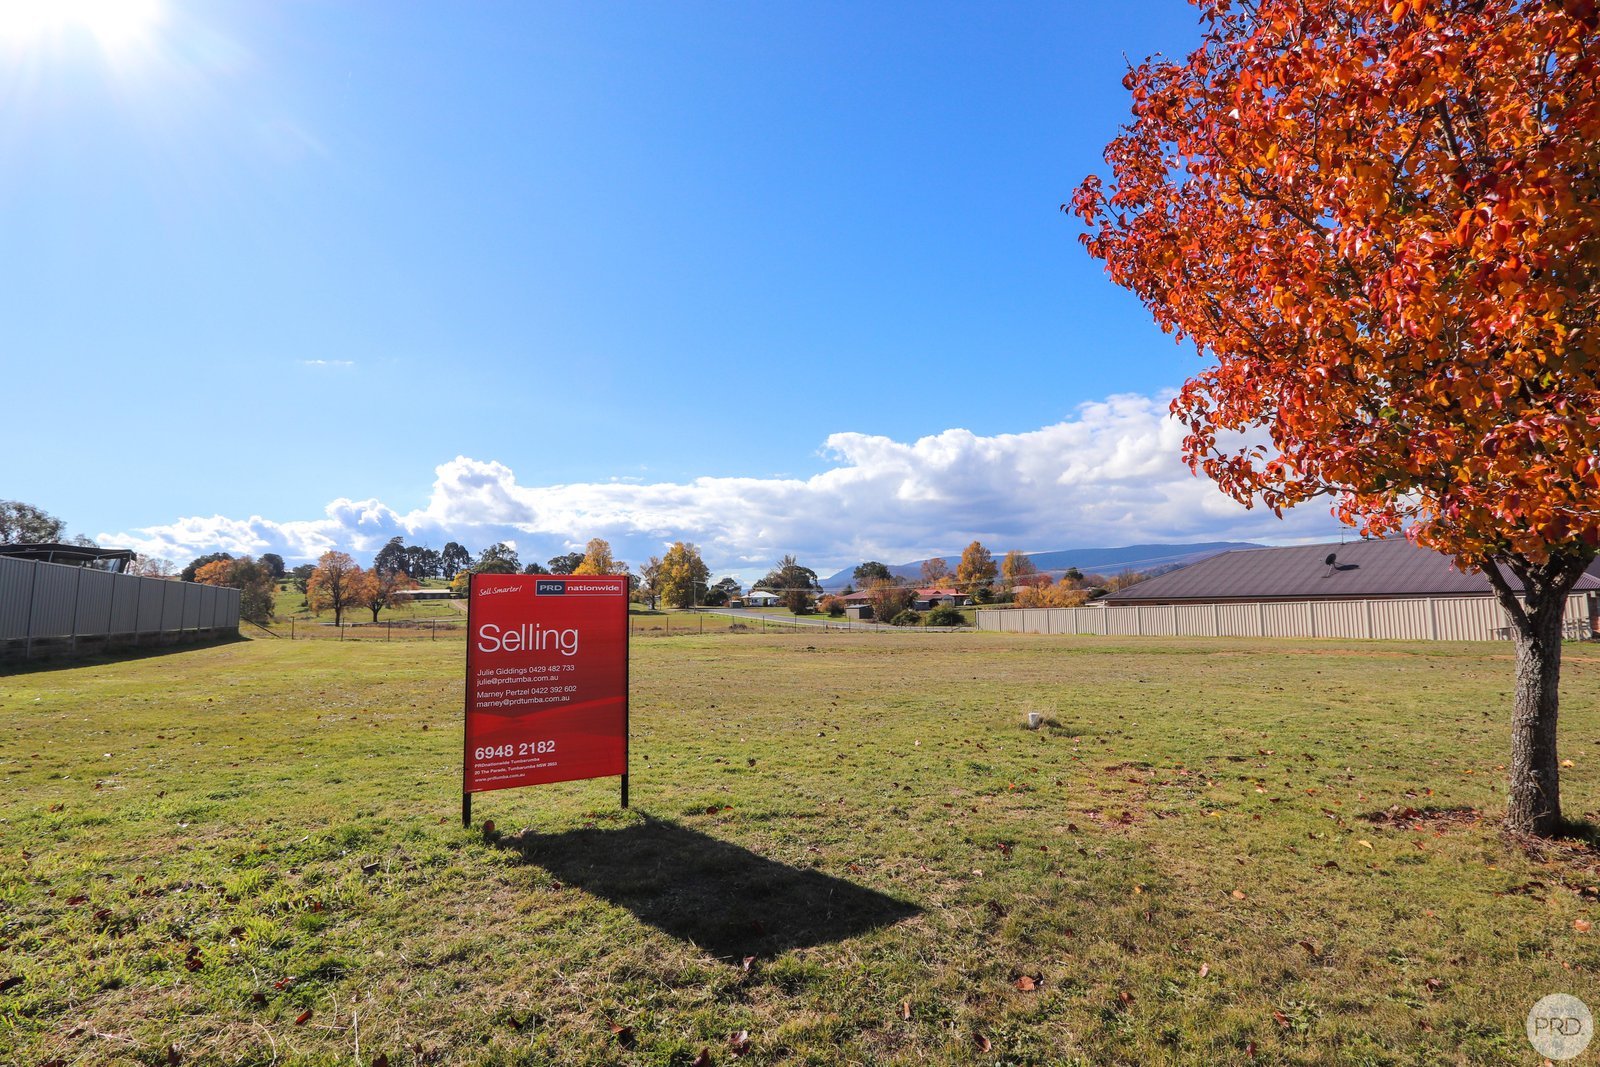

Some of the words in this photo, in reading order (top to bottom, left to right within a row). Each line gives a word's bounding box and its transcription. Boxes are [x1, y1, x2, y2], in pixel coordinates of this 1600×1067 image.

[479, 586, 492, 596] Sell
[493, 585, 523, 595] Smarter!
[477, 623, 579, 656] Selling
[477, 669, 494, 677] Julie
[496, 667, 528, 676] Giddings
[562, 664, 575, 672] 733
[476, 674, 559, 687] julie@prdtumba.com.au
[476, 691, 504, 699] Marney
[505, 688, 530, 696] Pertzel
[531, 687, 548, 695] 0422
[476, 695, 570, 708] marney@prdtumba.com.au
[474, 744, 514, 760] 6948
[518, 740, 556, 756] 2182
